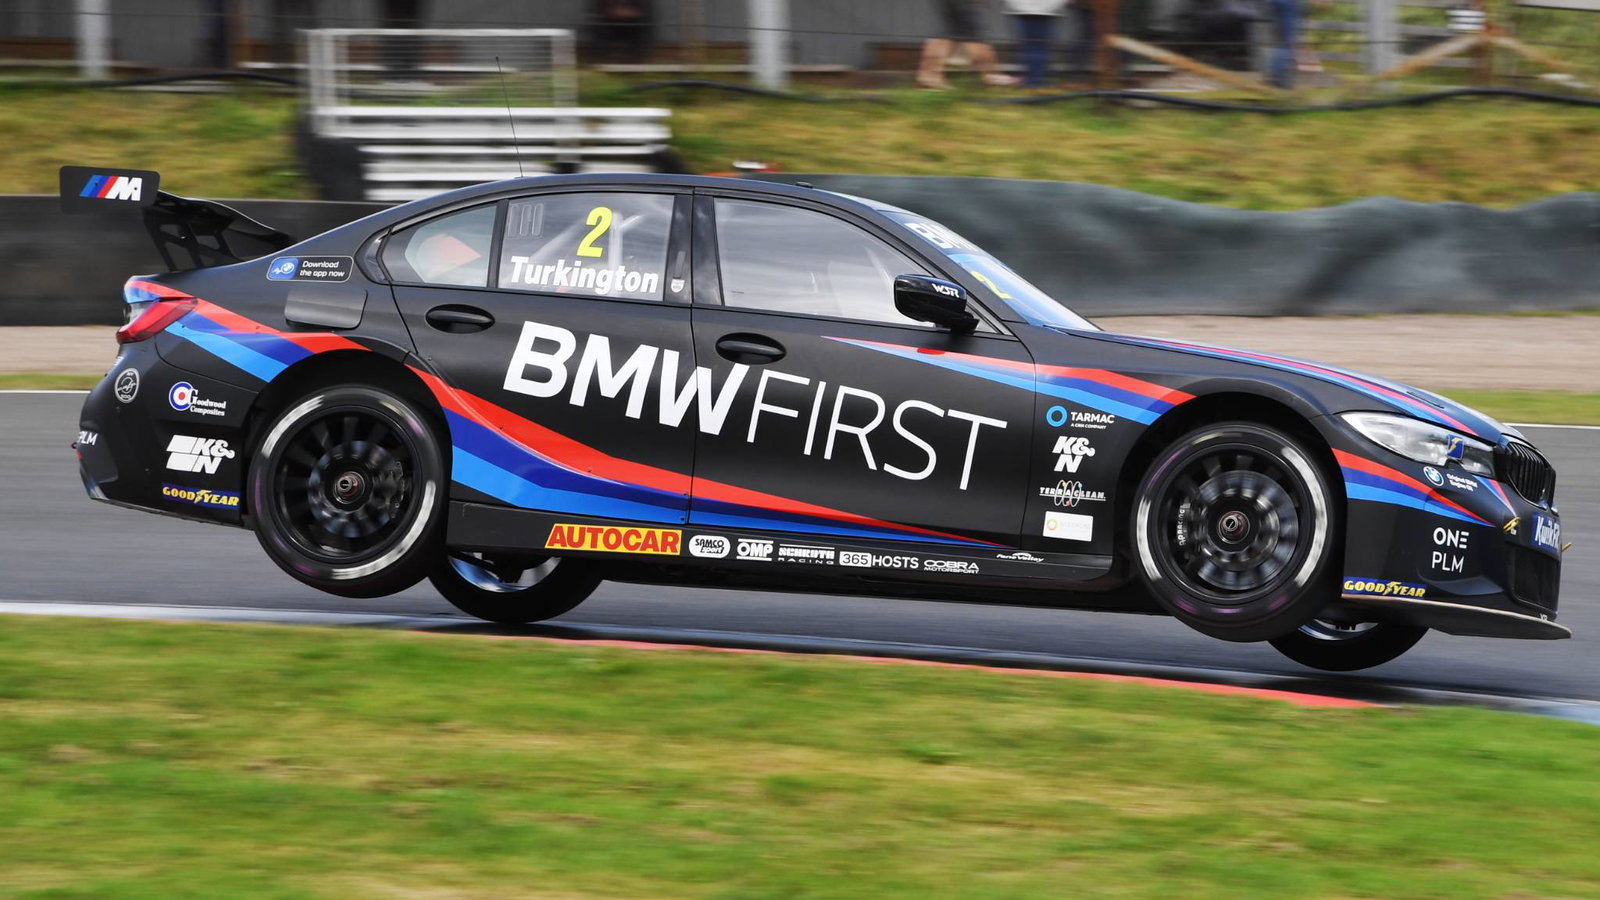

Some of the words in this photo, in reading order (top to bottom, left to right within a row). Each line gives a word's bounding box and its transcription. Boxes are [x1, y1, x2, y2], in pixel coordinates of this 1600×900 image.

[576, 206, 613, 257] 2
[302, 260, 339, 269] Download
[300, 269, 312, 277] the
[313, 270, 328, 279] app
[510, 255, 659, 295] Turkington
[931, 283, 960, 298] WSR
[188, 388, 227, 410] Goodwood
[190, 406, 225, 417] Composites
[1071, 411, 1115, 424] TARMAC
[547, 525, 680, 554] AUTOCAR
[695, 538, 725, 548] SAMCO
[1432, 527, 1470, 549] ONE
[737, 542, 774, 558] OMP
[778, 547, 835, 560] SCHROTH
[778, 557, 835, 565] RACING
[842, 553, 869, 565] 365
[872, 555, 919, 569] HOSTS
[924, 559, 979, 570] COBRA
[1432, 551, 1465, 573] PLM
[924, 566, 979, 574] MOTORSPORT
[1344, 580, 1426, 598] GOODYEAR
